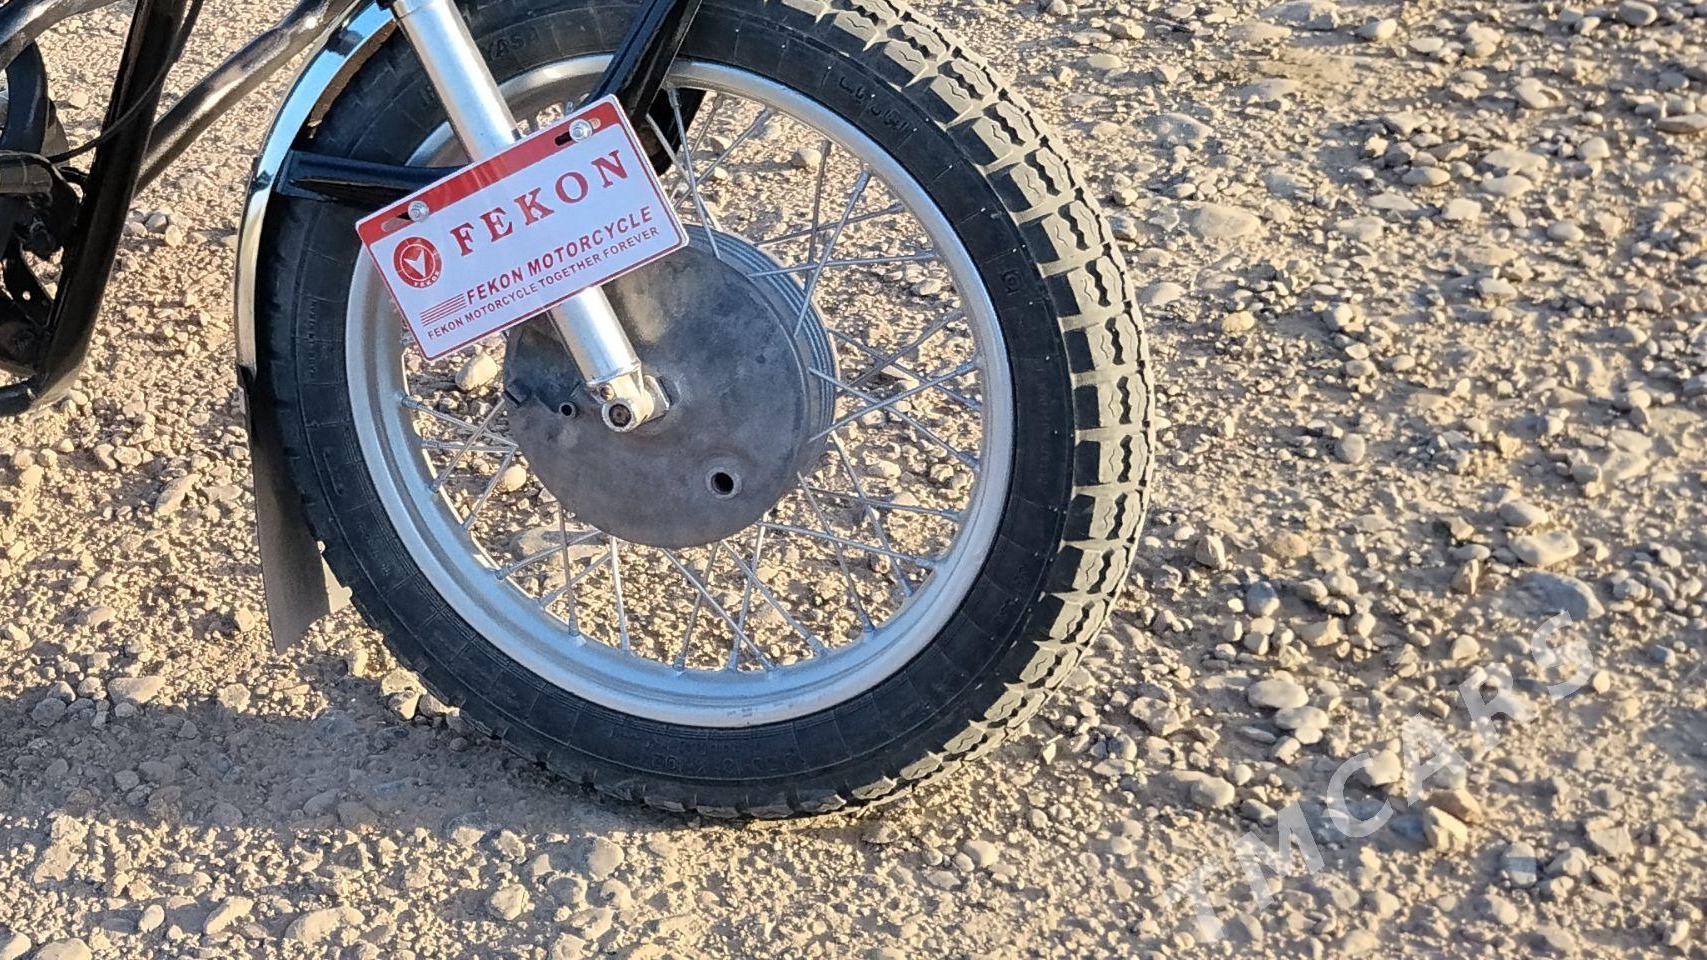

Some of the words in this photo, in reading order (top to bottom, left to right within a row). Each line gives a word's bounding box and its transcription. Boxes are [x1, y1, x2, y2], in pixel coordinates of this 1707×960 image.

[450, 149, 629, 257] FEKON
[466, 267, 524, 305] FEKON
[527, 206, 654, 274] MOTORCYCLE
[427, 318, 464, 340] FEKON
[465, 282, 538, 324] MOTORCYCLE
[539, 254, 603, 288] TOGETHER
[603, 227, 660, 261] FOREVER
